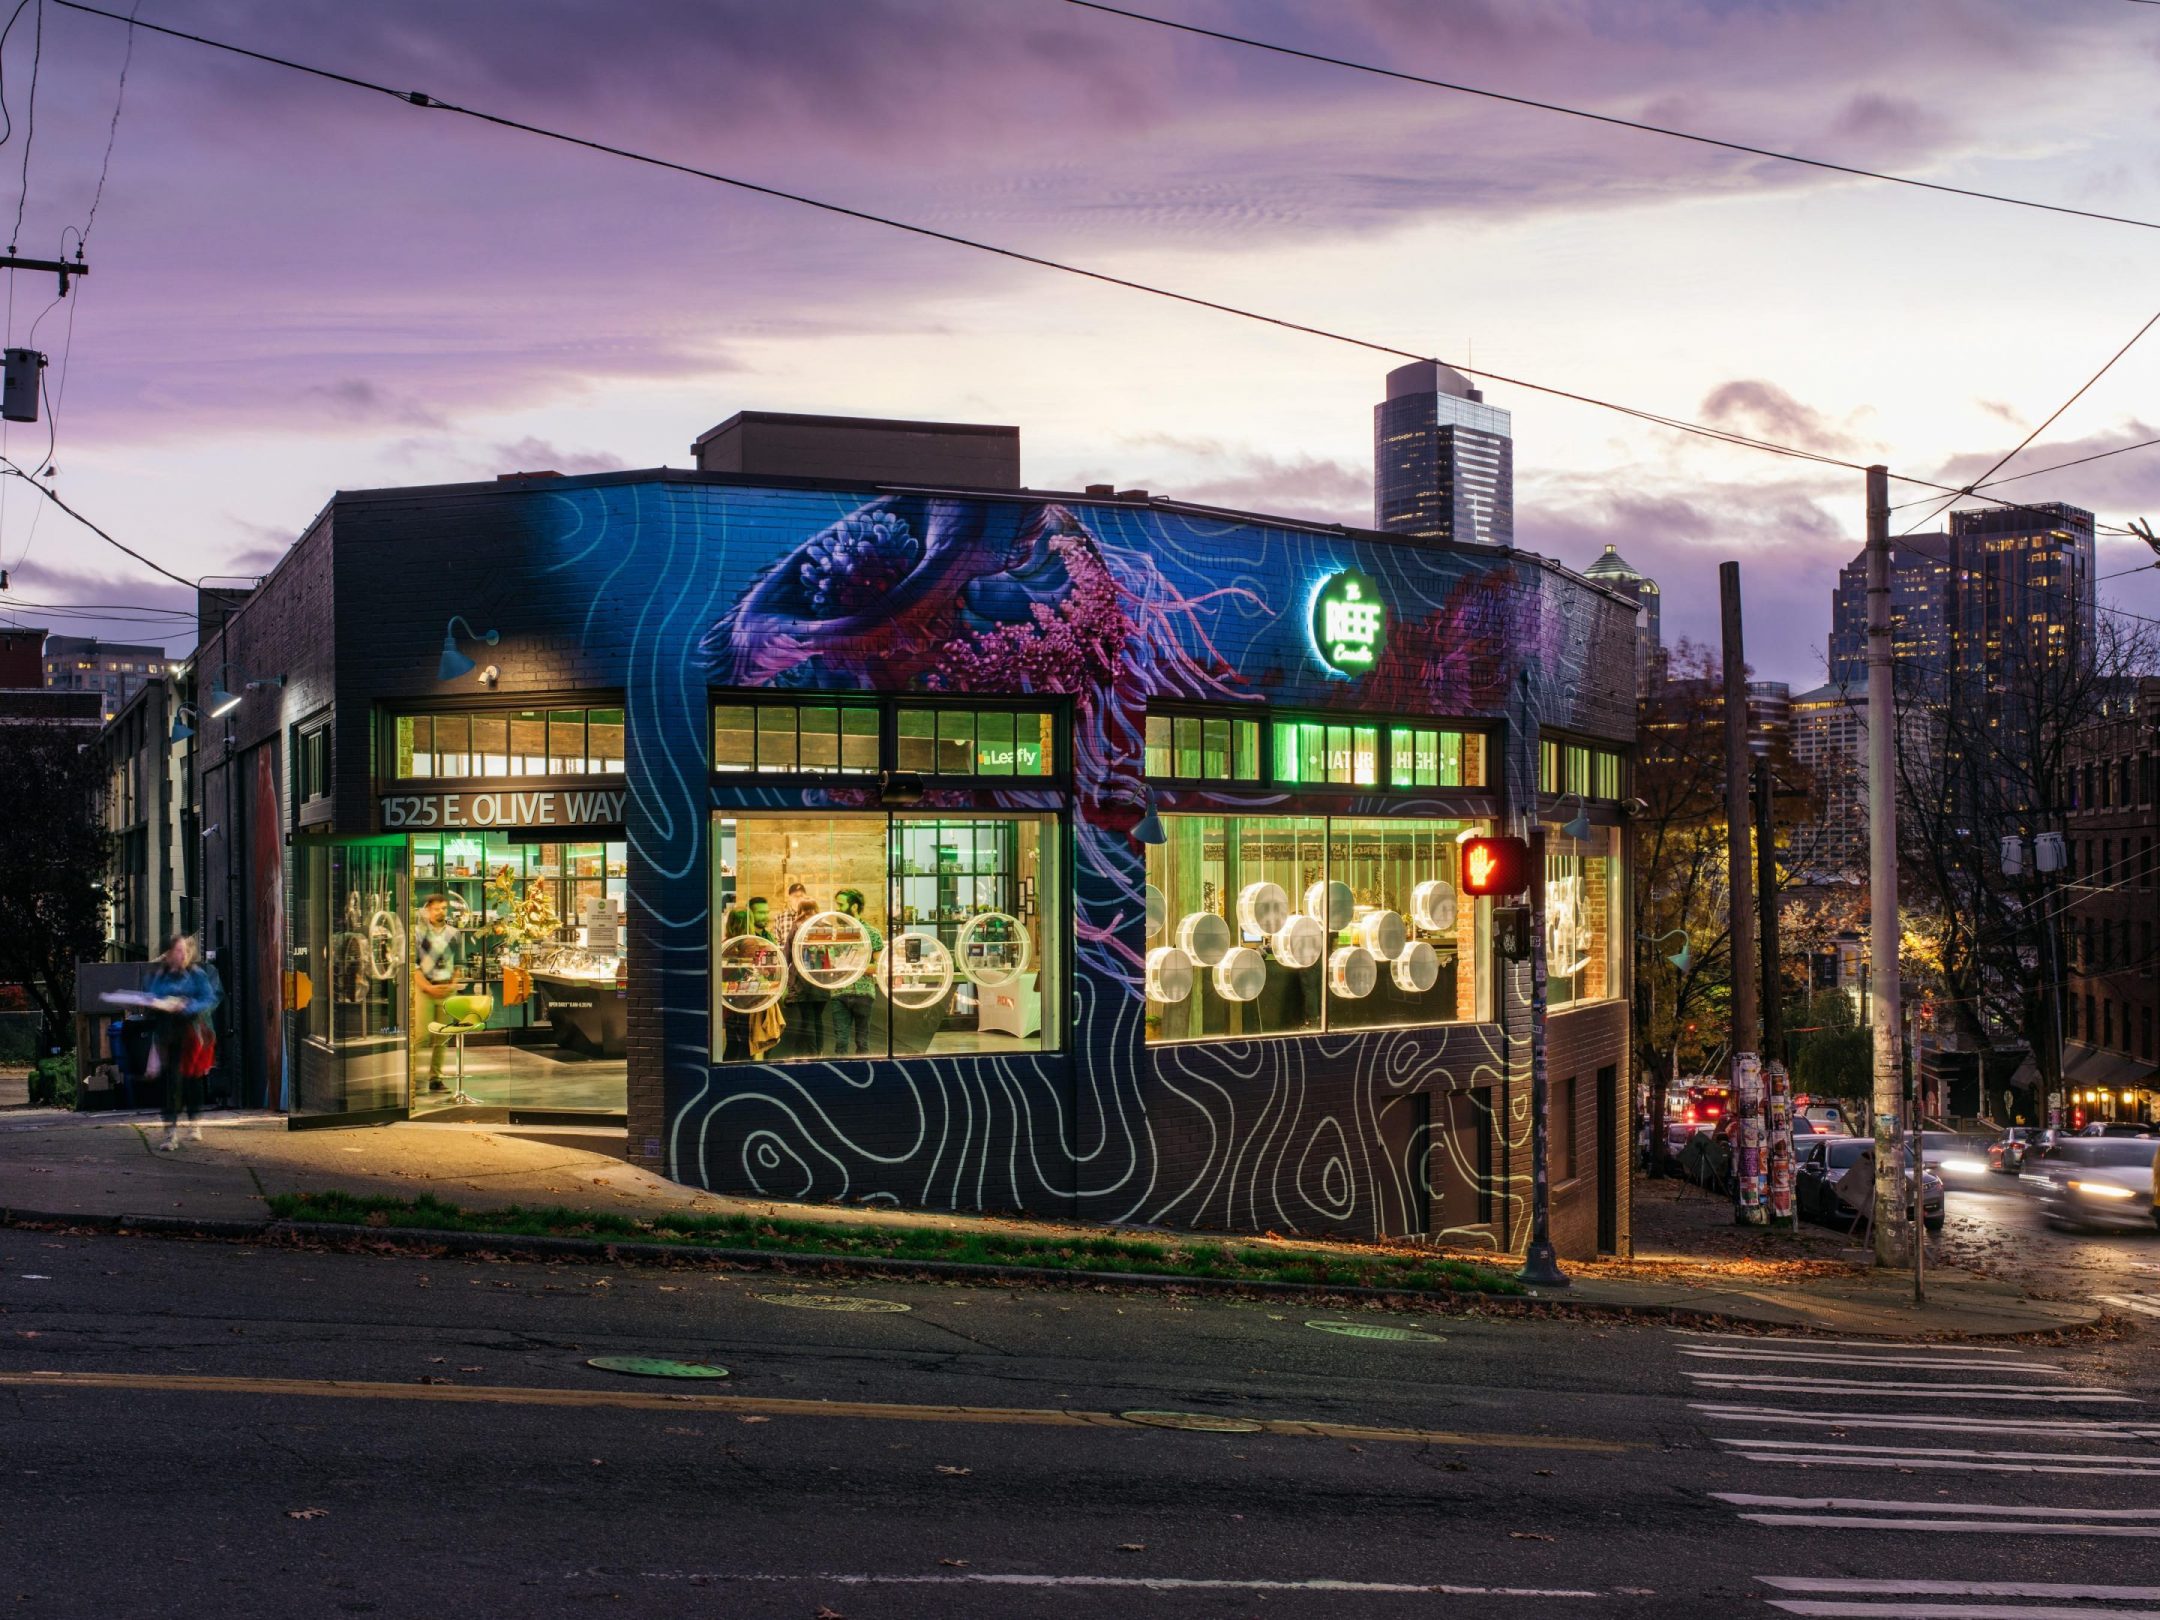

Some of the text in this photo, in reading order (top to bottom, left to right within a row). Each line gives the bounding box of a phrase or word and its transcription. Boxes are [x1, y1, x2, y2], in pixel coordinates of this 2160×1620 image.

[1326, 601, 1380, 643] REEF
[991, 748, 1037, 766] Leafly
[1397, 752, 1444, 770] HIGHS
[381, 791, 626, 826] 1525 E. OLIVE WAY
